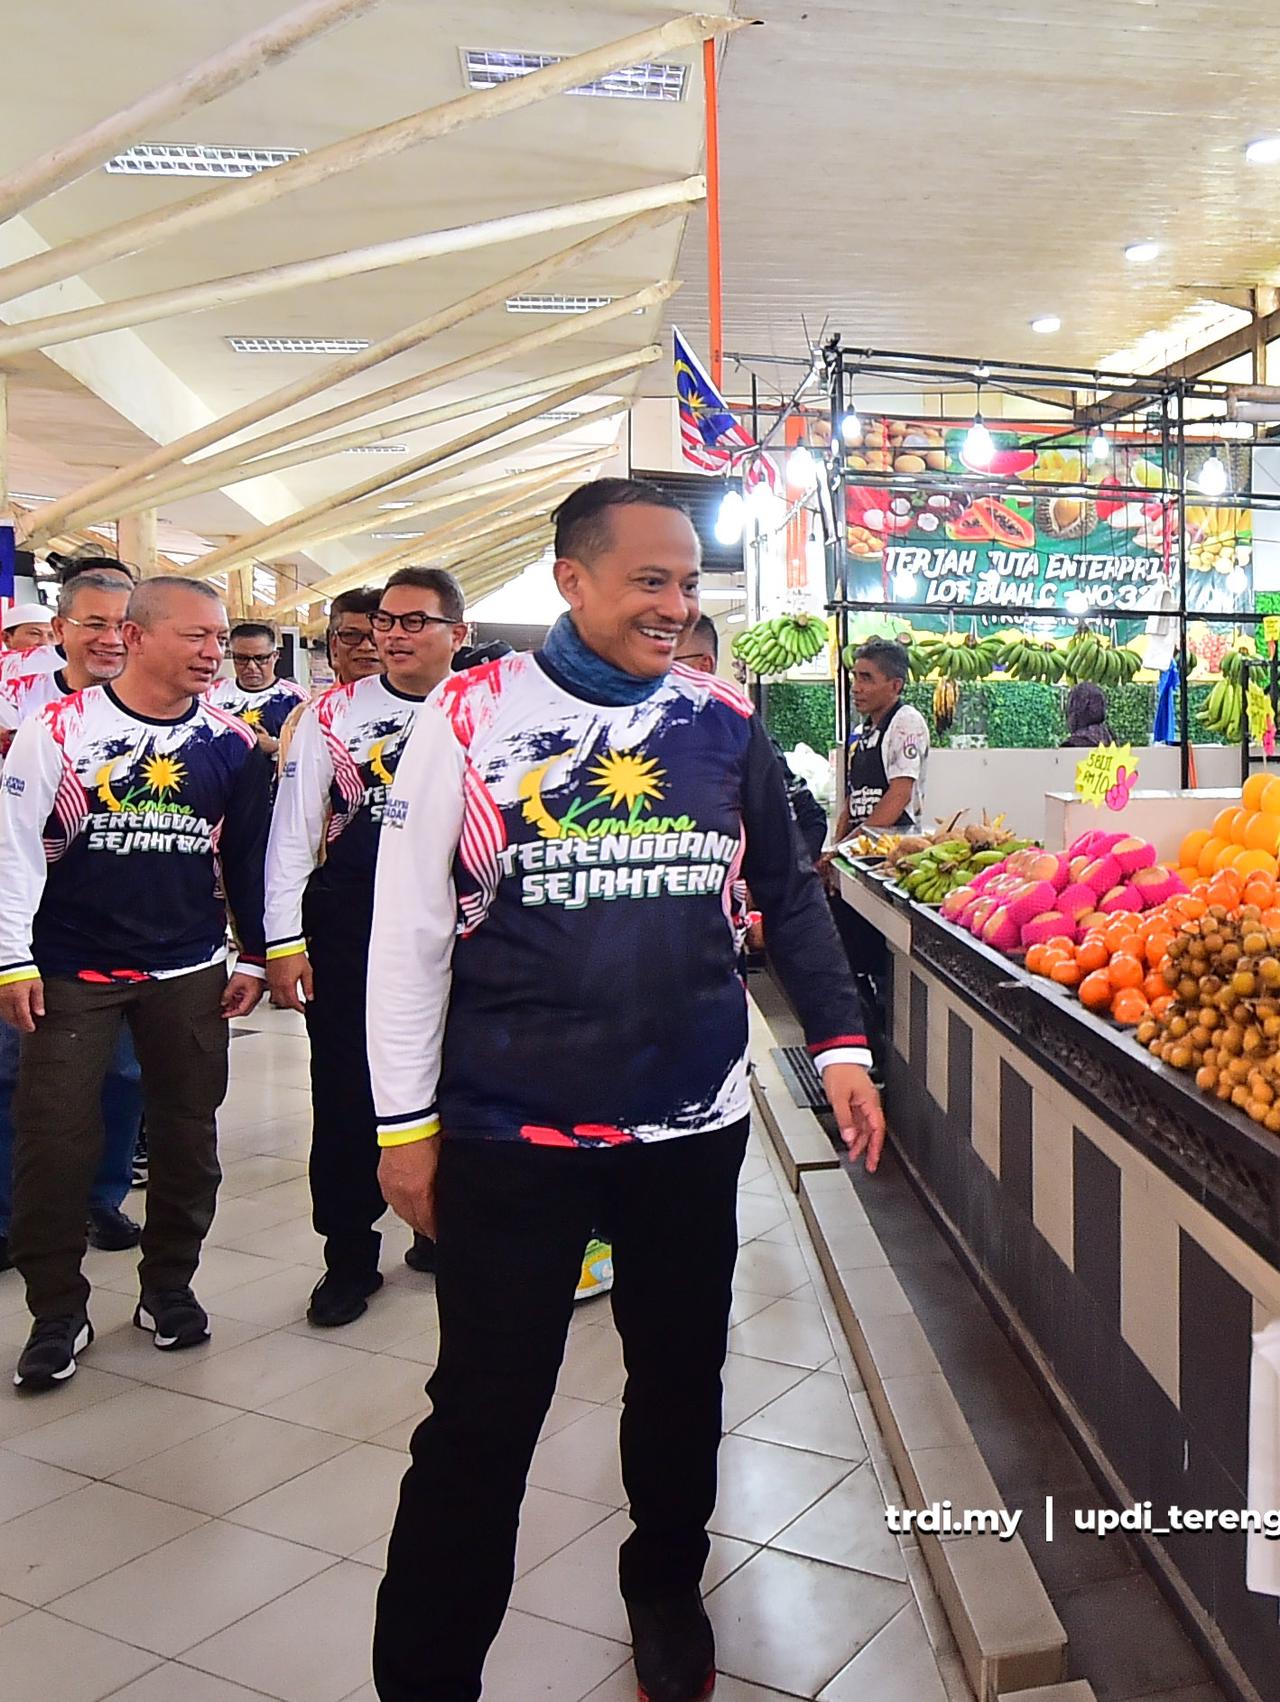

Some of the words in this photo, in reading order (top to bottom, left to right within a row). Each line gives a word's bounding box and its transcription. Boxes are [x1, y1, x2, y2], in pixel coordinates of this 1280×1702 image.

[883, 546, 977, 579] TERJAH
[925, 578, 971, 604] LOT
[973, 578, 1035, 606] BUAH
[559, 795, 697, 841] Kembara
[497, 831, 741, 878] TERENGGANU
[521, 863, 725, 910] SEJAHTERA
